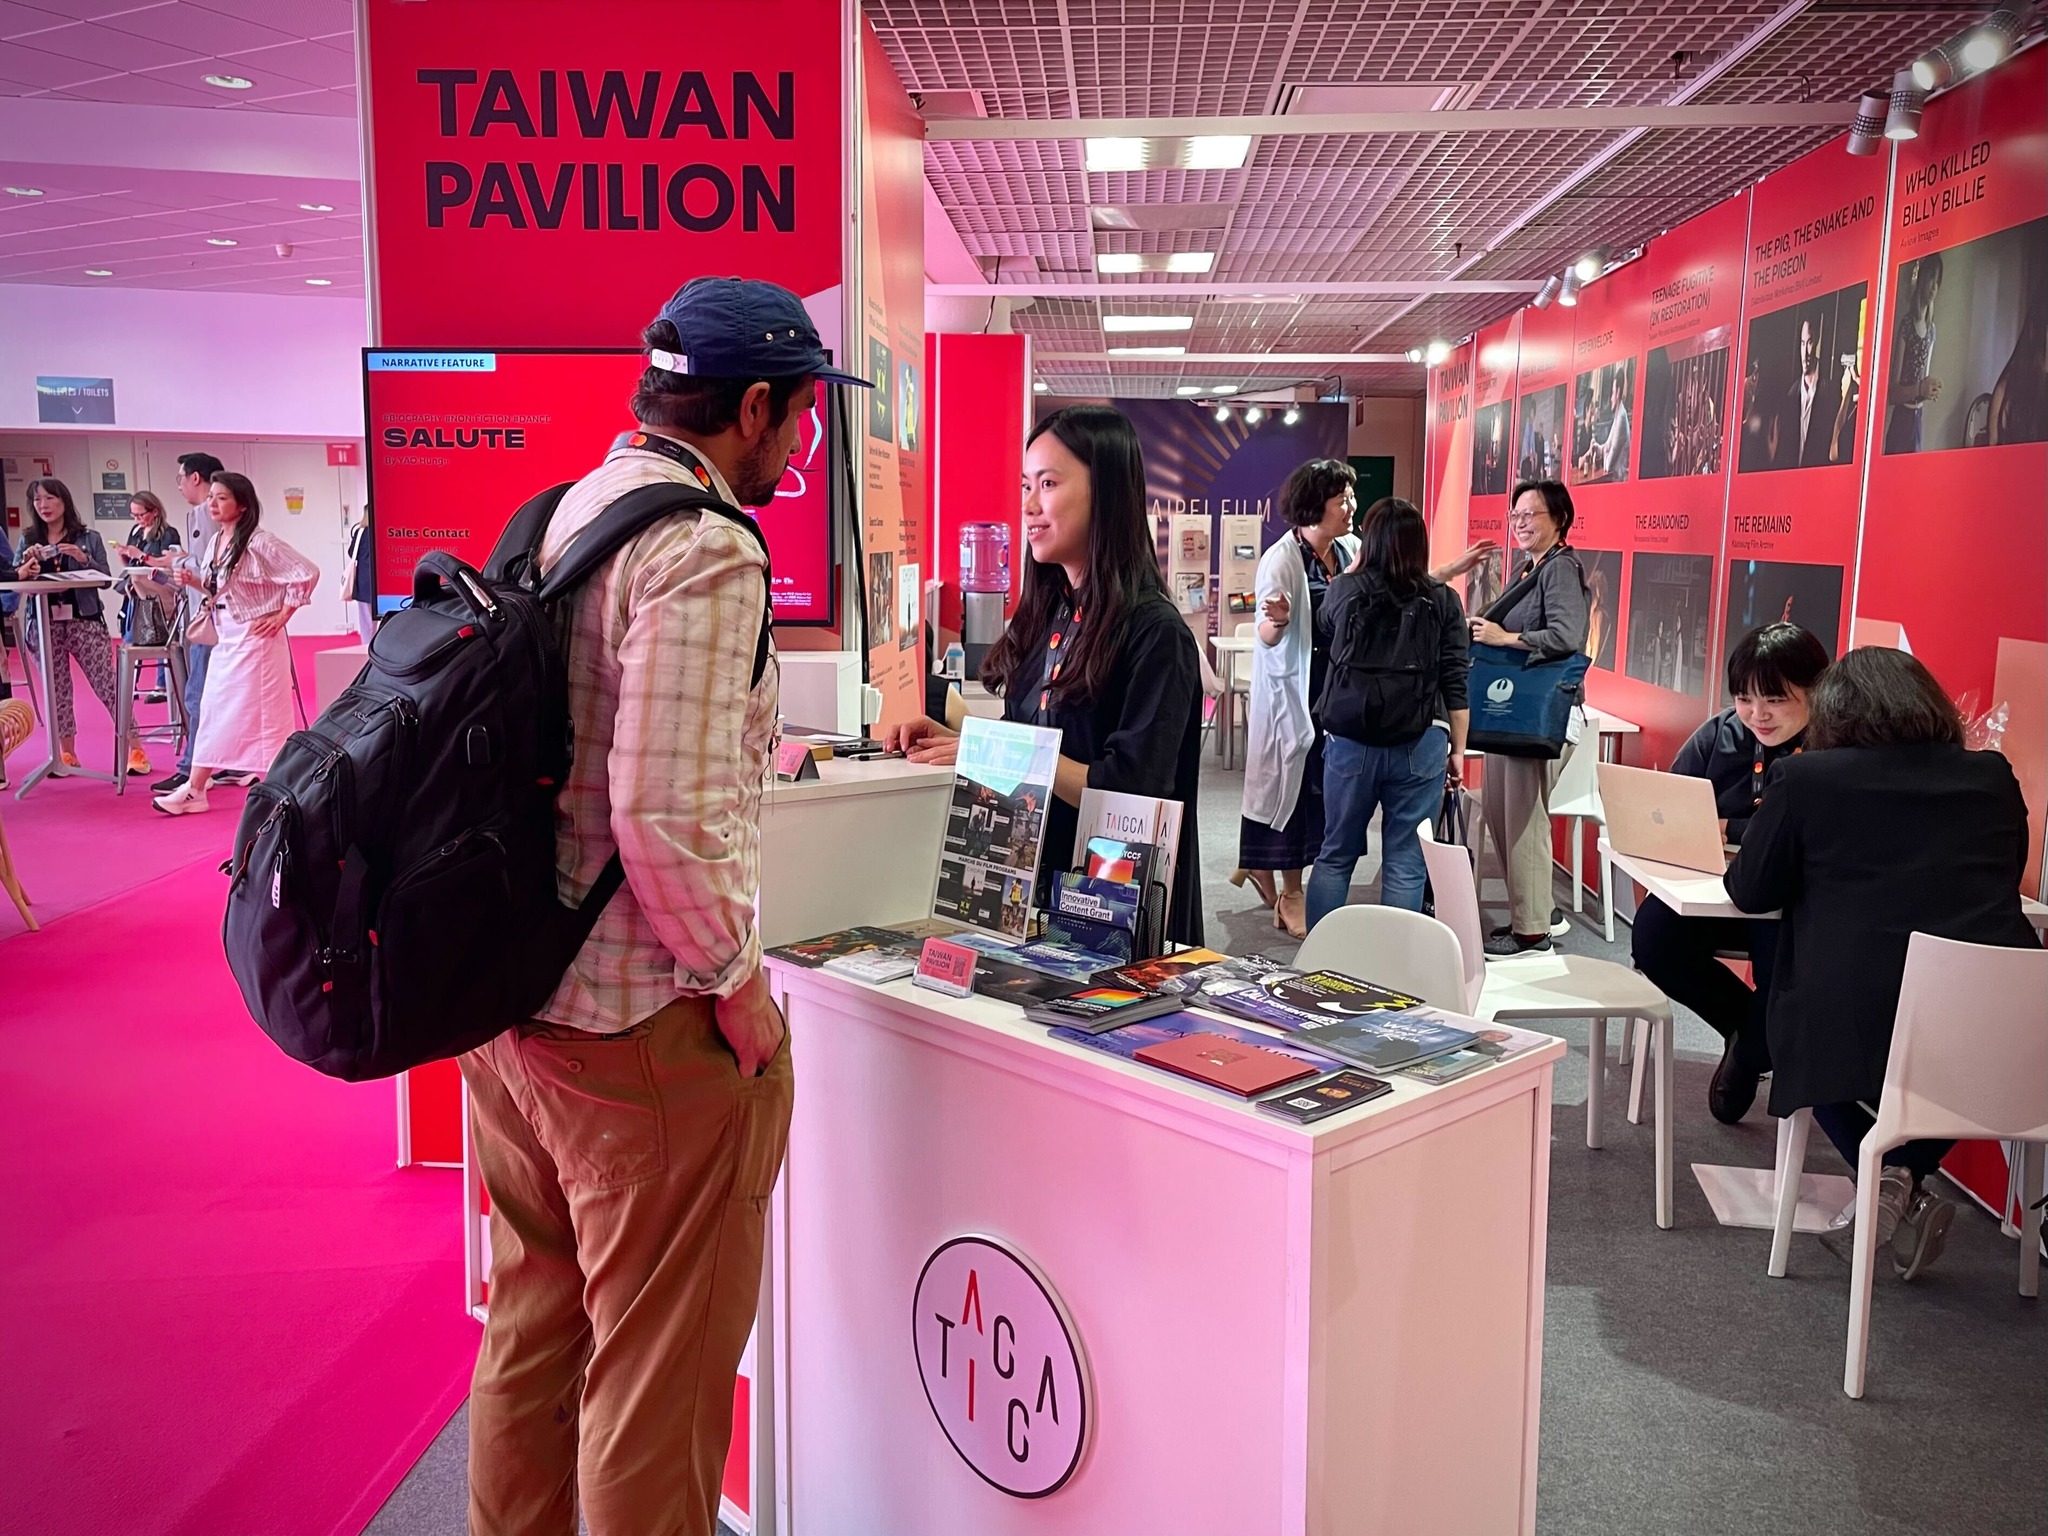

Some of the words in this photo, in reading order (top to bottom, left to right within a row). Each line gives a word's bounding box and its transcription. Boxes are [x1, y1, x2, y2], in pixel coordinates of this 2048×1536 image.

[416, 69, 796, 140] TAIWAN
[1905, 163, 1938, 196] WHO
[1940, 140, 1991, 182] KILLED
[425, 161, 796, 233] PAVILION
[1903, 193, 1939, 228] BILLY
[1941, 174, 1986, 213] BILLIE
[1755, 240, 1773, 264] THE
[1773, 233, 1791, 256] PIG,
[1793, 222, 1812, 248] THE
[1813, 206, 1849, 239] SNAKE
[1849, 195, 1875, 224] AND
[1753, 266, 1771, 290] THE
[1771, 252, 1807, 283] PIGEON
[1651, 280, 1681, 305] TEENAGE
[1681, 265, 1715, 293] FUGITIVE
[1649, 307, 1660, 331] (2K
[1660, 286, 1712, 322] RESTORATION)
[1587, 329, 1614, 350] ENVELOPE
[382, 358, 439, 368] NARRATIVE
[441, 358, 485, 368] FEATURE
[1440, 359, 1470, 395] TAIWAN
[83, 387, 109, 397] TOILETS
[1438, 393, 1469, 425] PAVILION
[384, 428, 525, 448] SALUTE
[385, 456, 396, 465] By
[399, 456, 417, 465] YAO
[1152, 499, 1208, 522] AIPEI
[388, 528, 419, 538] Sales
[422, 528, 470, 538] Contact
[1635, 515, 1647, 530] THE
[1648, 515, 1689, 530] ABANDONED
[1734, 516, 1750, 534] THE
[1751, 516, 1792, 534] REMAINS
[1106, 812, 1145, 836] TAICCA
[1061, 891, 1099, 908] Innovative
[1060, 902, 1090, 916] Content
[1089, 908, 1111, 921] Grant
[926, 956, 951, 969] PAVILION
[928, 948, 952, 962] TAIWAN
[934, 1268, 1060, 1464] TAICCA
